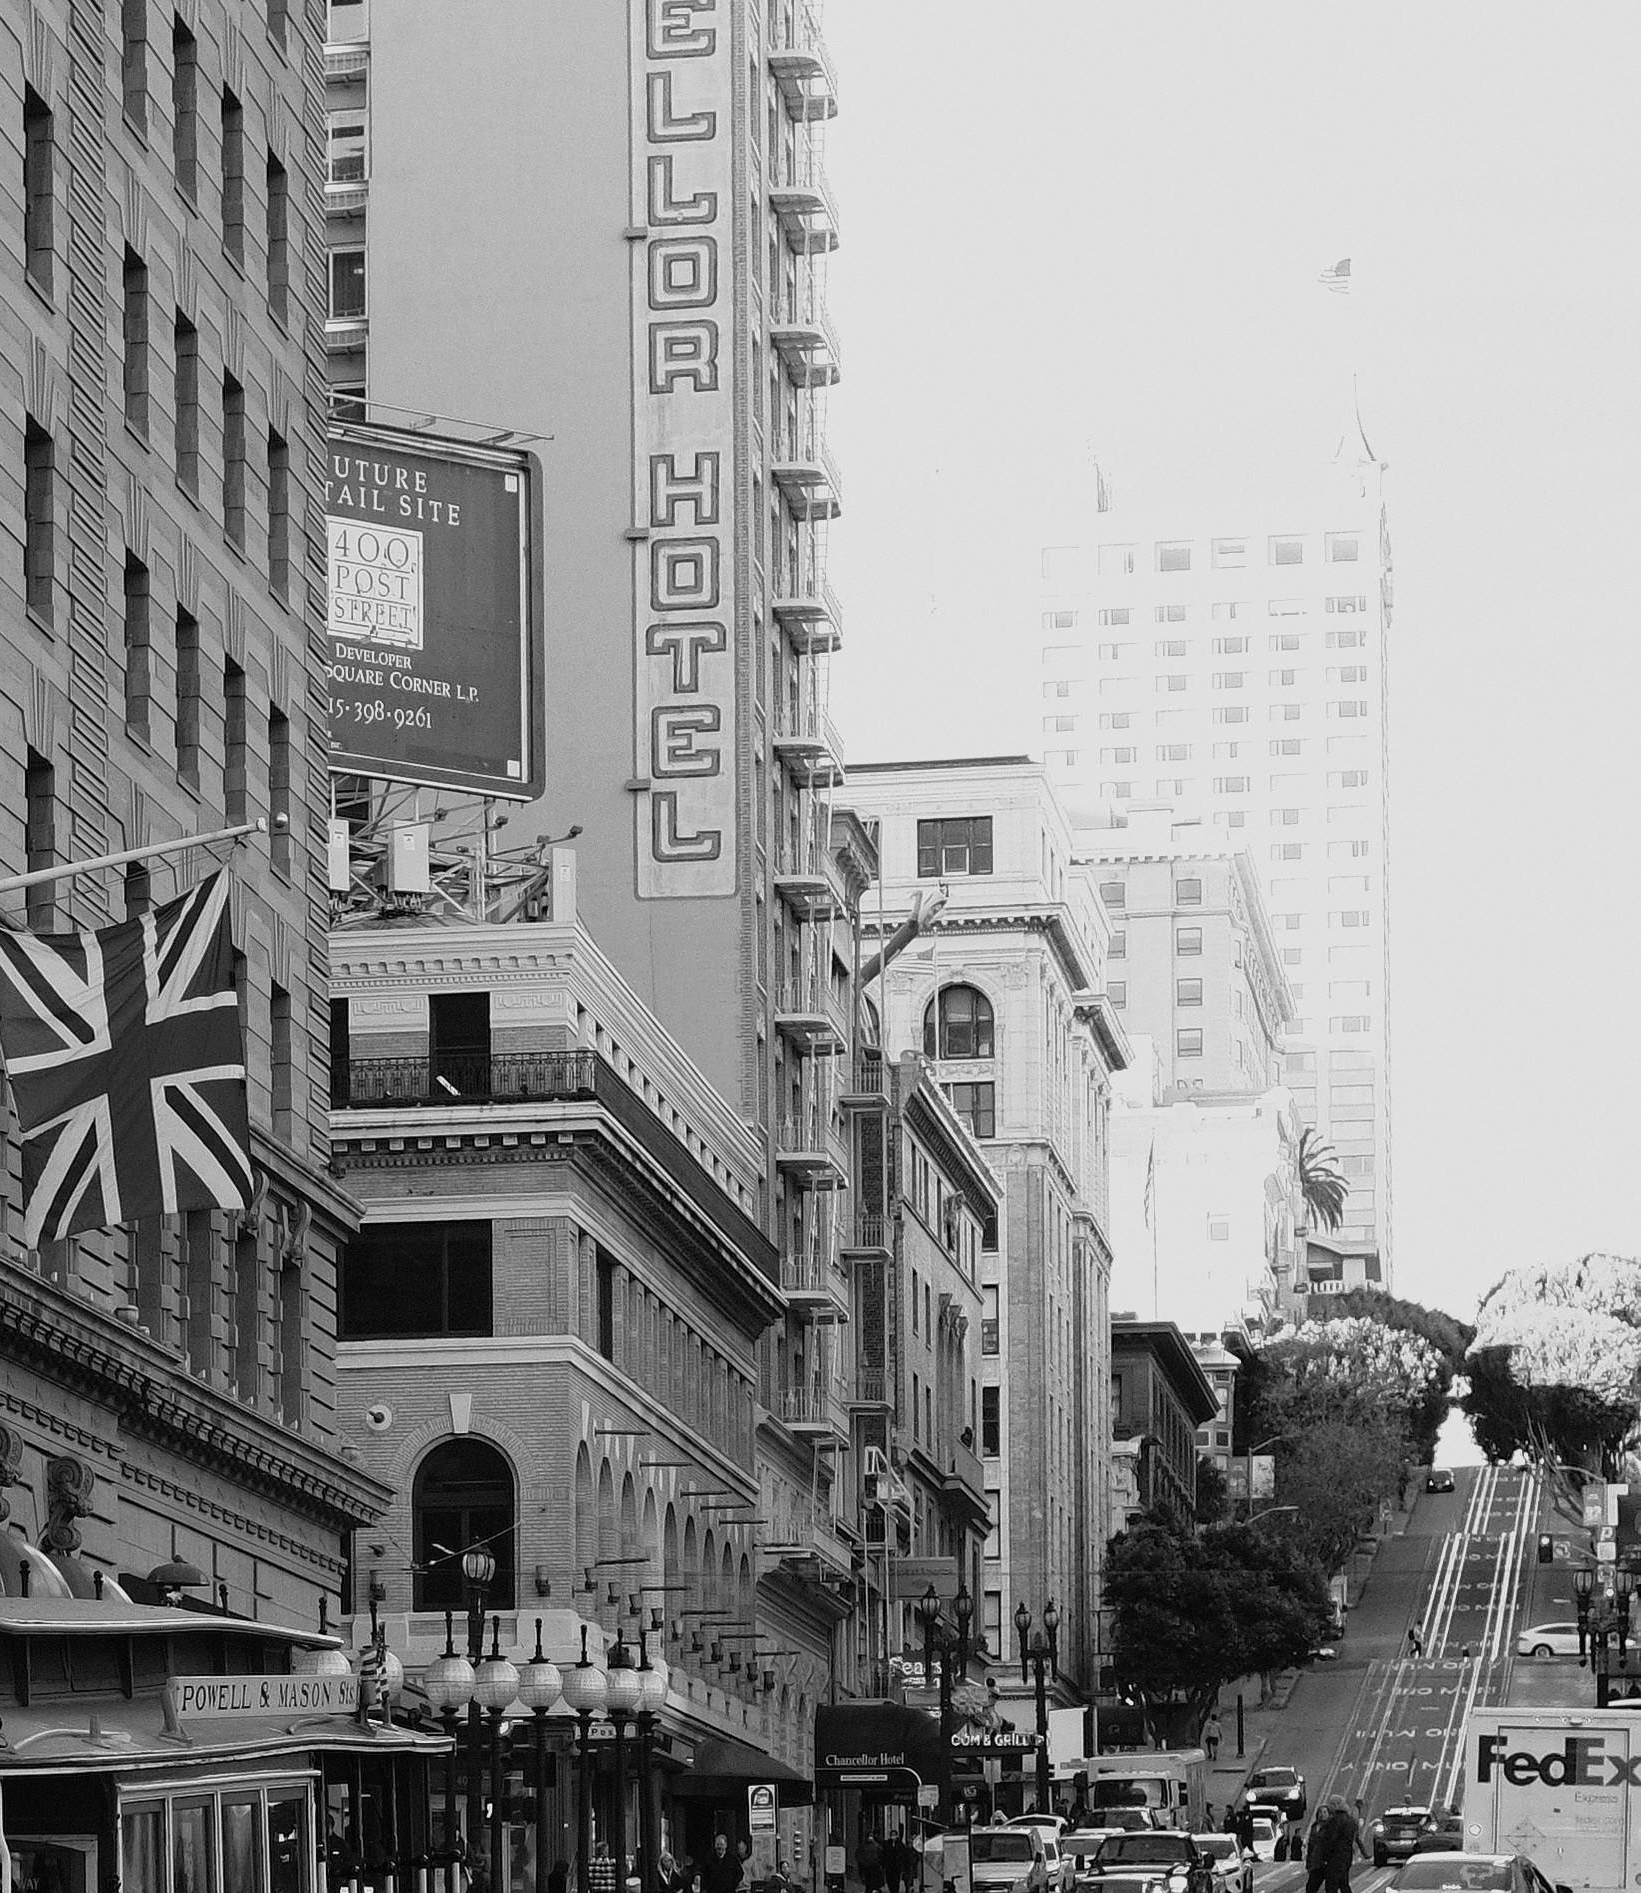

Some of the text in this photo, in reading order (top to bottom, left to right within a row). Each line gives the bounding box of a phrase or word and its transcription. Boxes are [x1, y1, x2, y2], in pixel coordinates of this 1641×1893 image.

[333, 455, 427, 493] UTURE
[400, 496, 460, 525] SITE
[335, 529, 409, 569] 400
[336, 565, 409, 600] POST
[334, 597, 412, 628] STREET
[336, 642, 412, 669] DEVELOPER
[646, 452, 726, 862] HOTEL
[390, 672, 451, 698] CORNER
[182, 1684, 251, 1711] POWELL
[259, 1681, 270, 1708] &
[278, 1682, 332, 1708] MASON
[994, 1732, 1029, 1746] GRILL
[825, 1751, 904, 1766] Chancellor Hotel
[1477, 1734, 1641, 1787] FedEx
